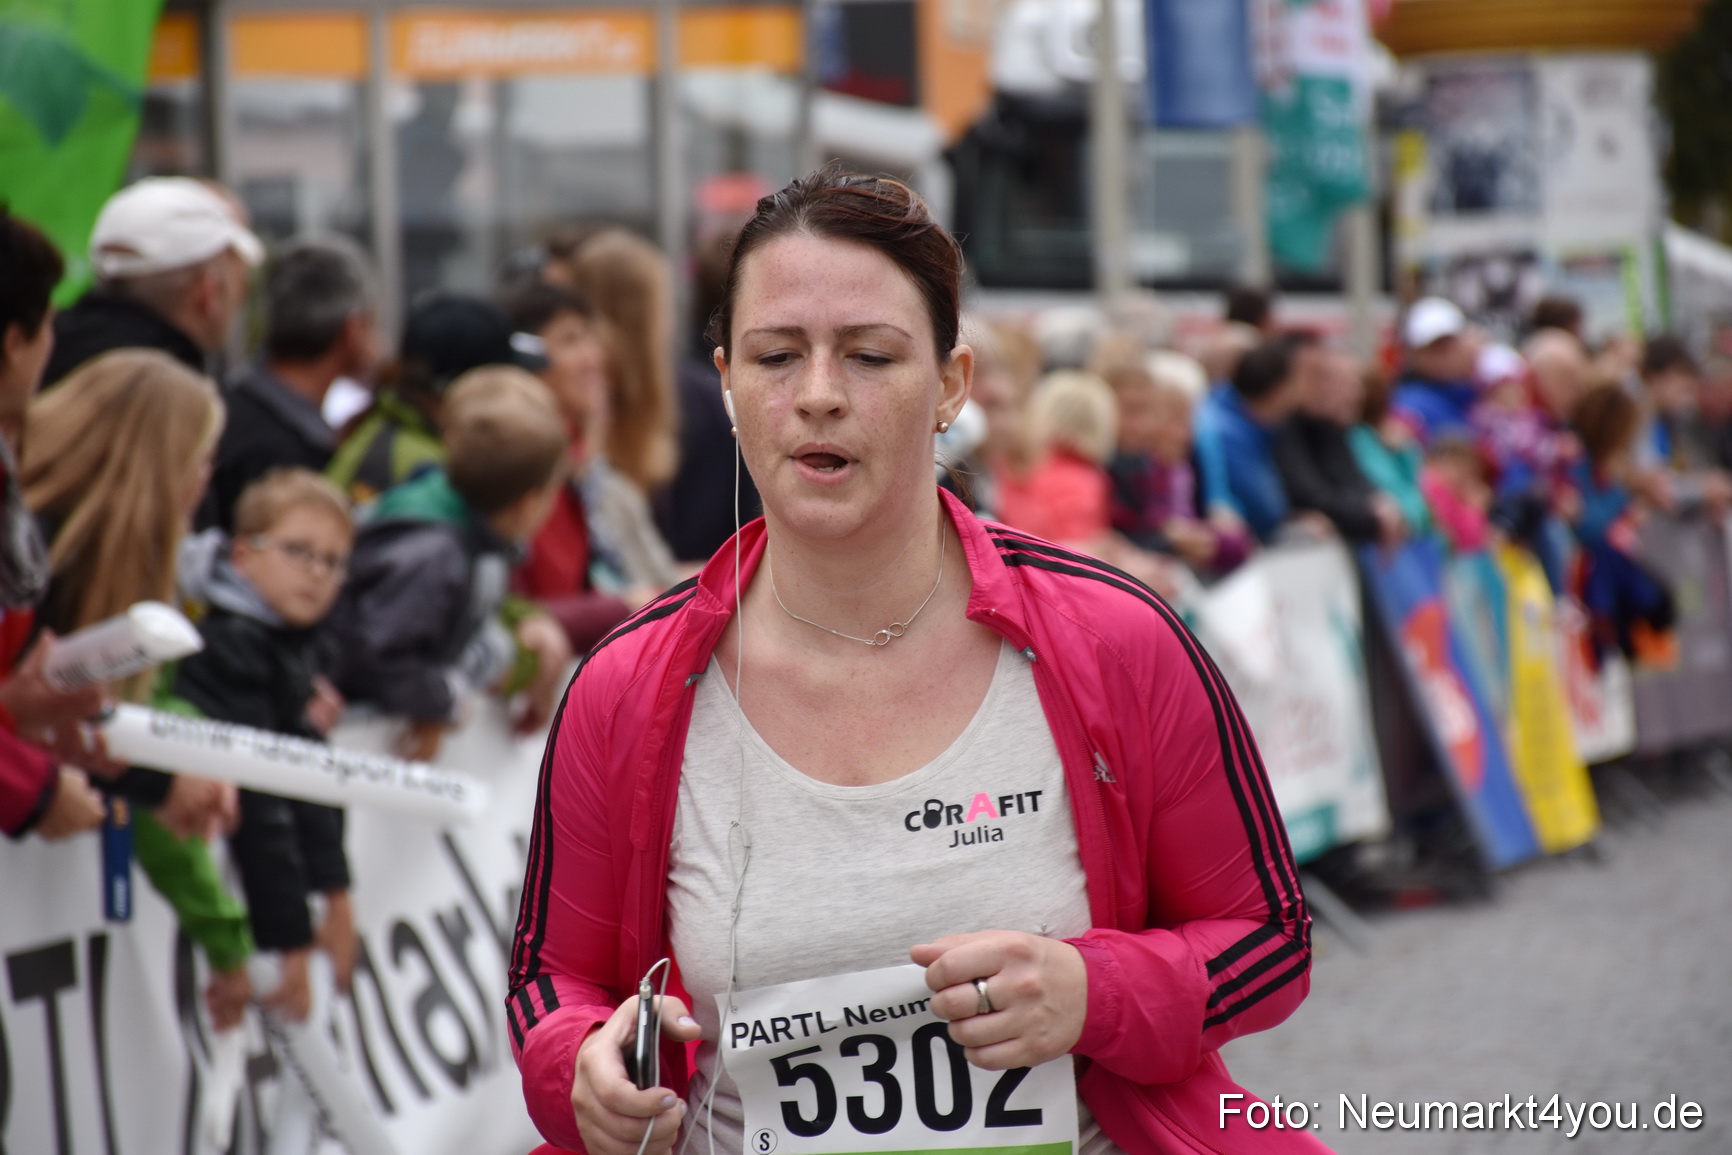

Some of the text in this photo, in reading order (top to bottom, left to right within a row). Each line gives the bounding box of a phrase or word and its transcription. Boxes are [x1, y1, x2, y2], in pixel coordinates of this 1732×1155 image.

[949, 825, 1004, 848] Julia
[731, 997, 932, 1049] PARTL Neum
[769, 1021, 1043, 1138] 5302
